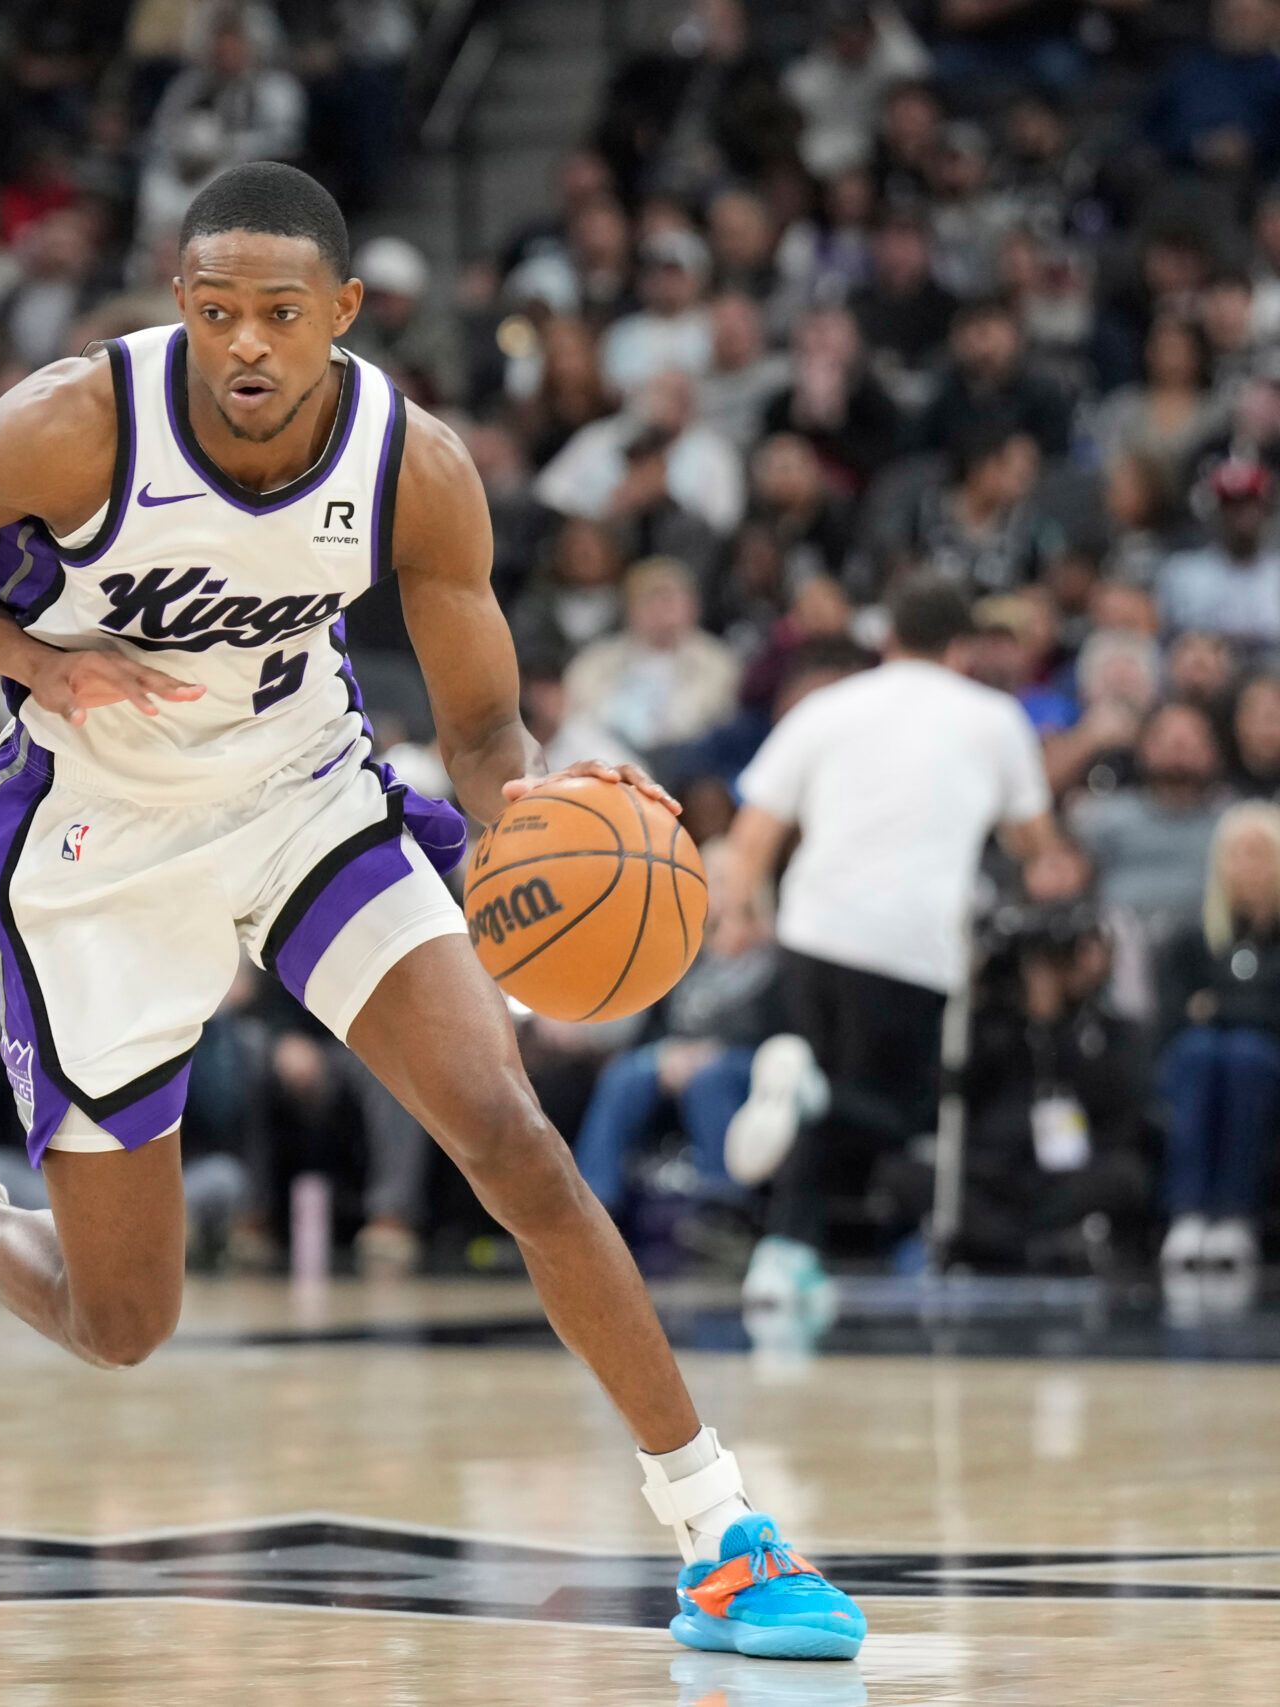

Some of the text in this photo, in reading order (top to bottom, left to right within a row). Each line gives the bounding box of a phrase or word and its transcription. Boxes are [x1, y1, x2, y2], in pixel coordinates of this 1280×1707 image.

[324, 502, 355, 529] R
[312, 536, 359, 544] REVIVER
[98, 567, 346, 653] Kings
[252, 650, 309, 715] 5
